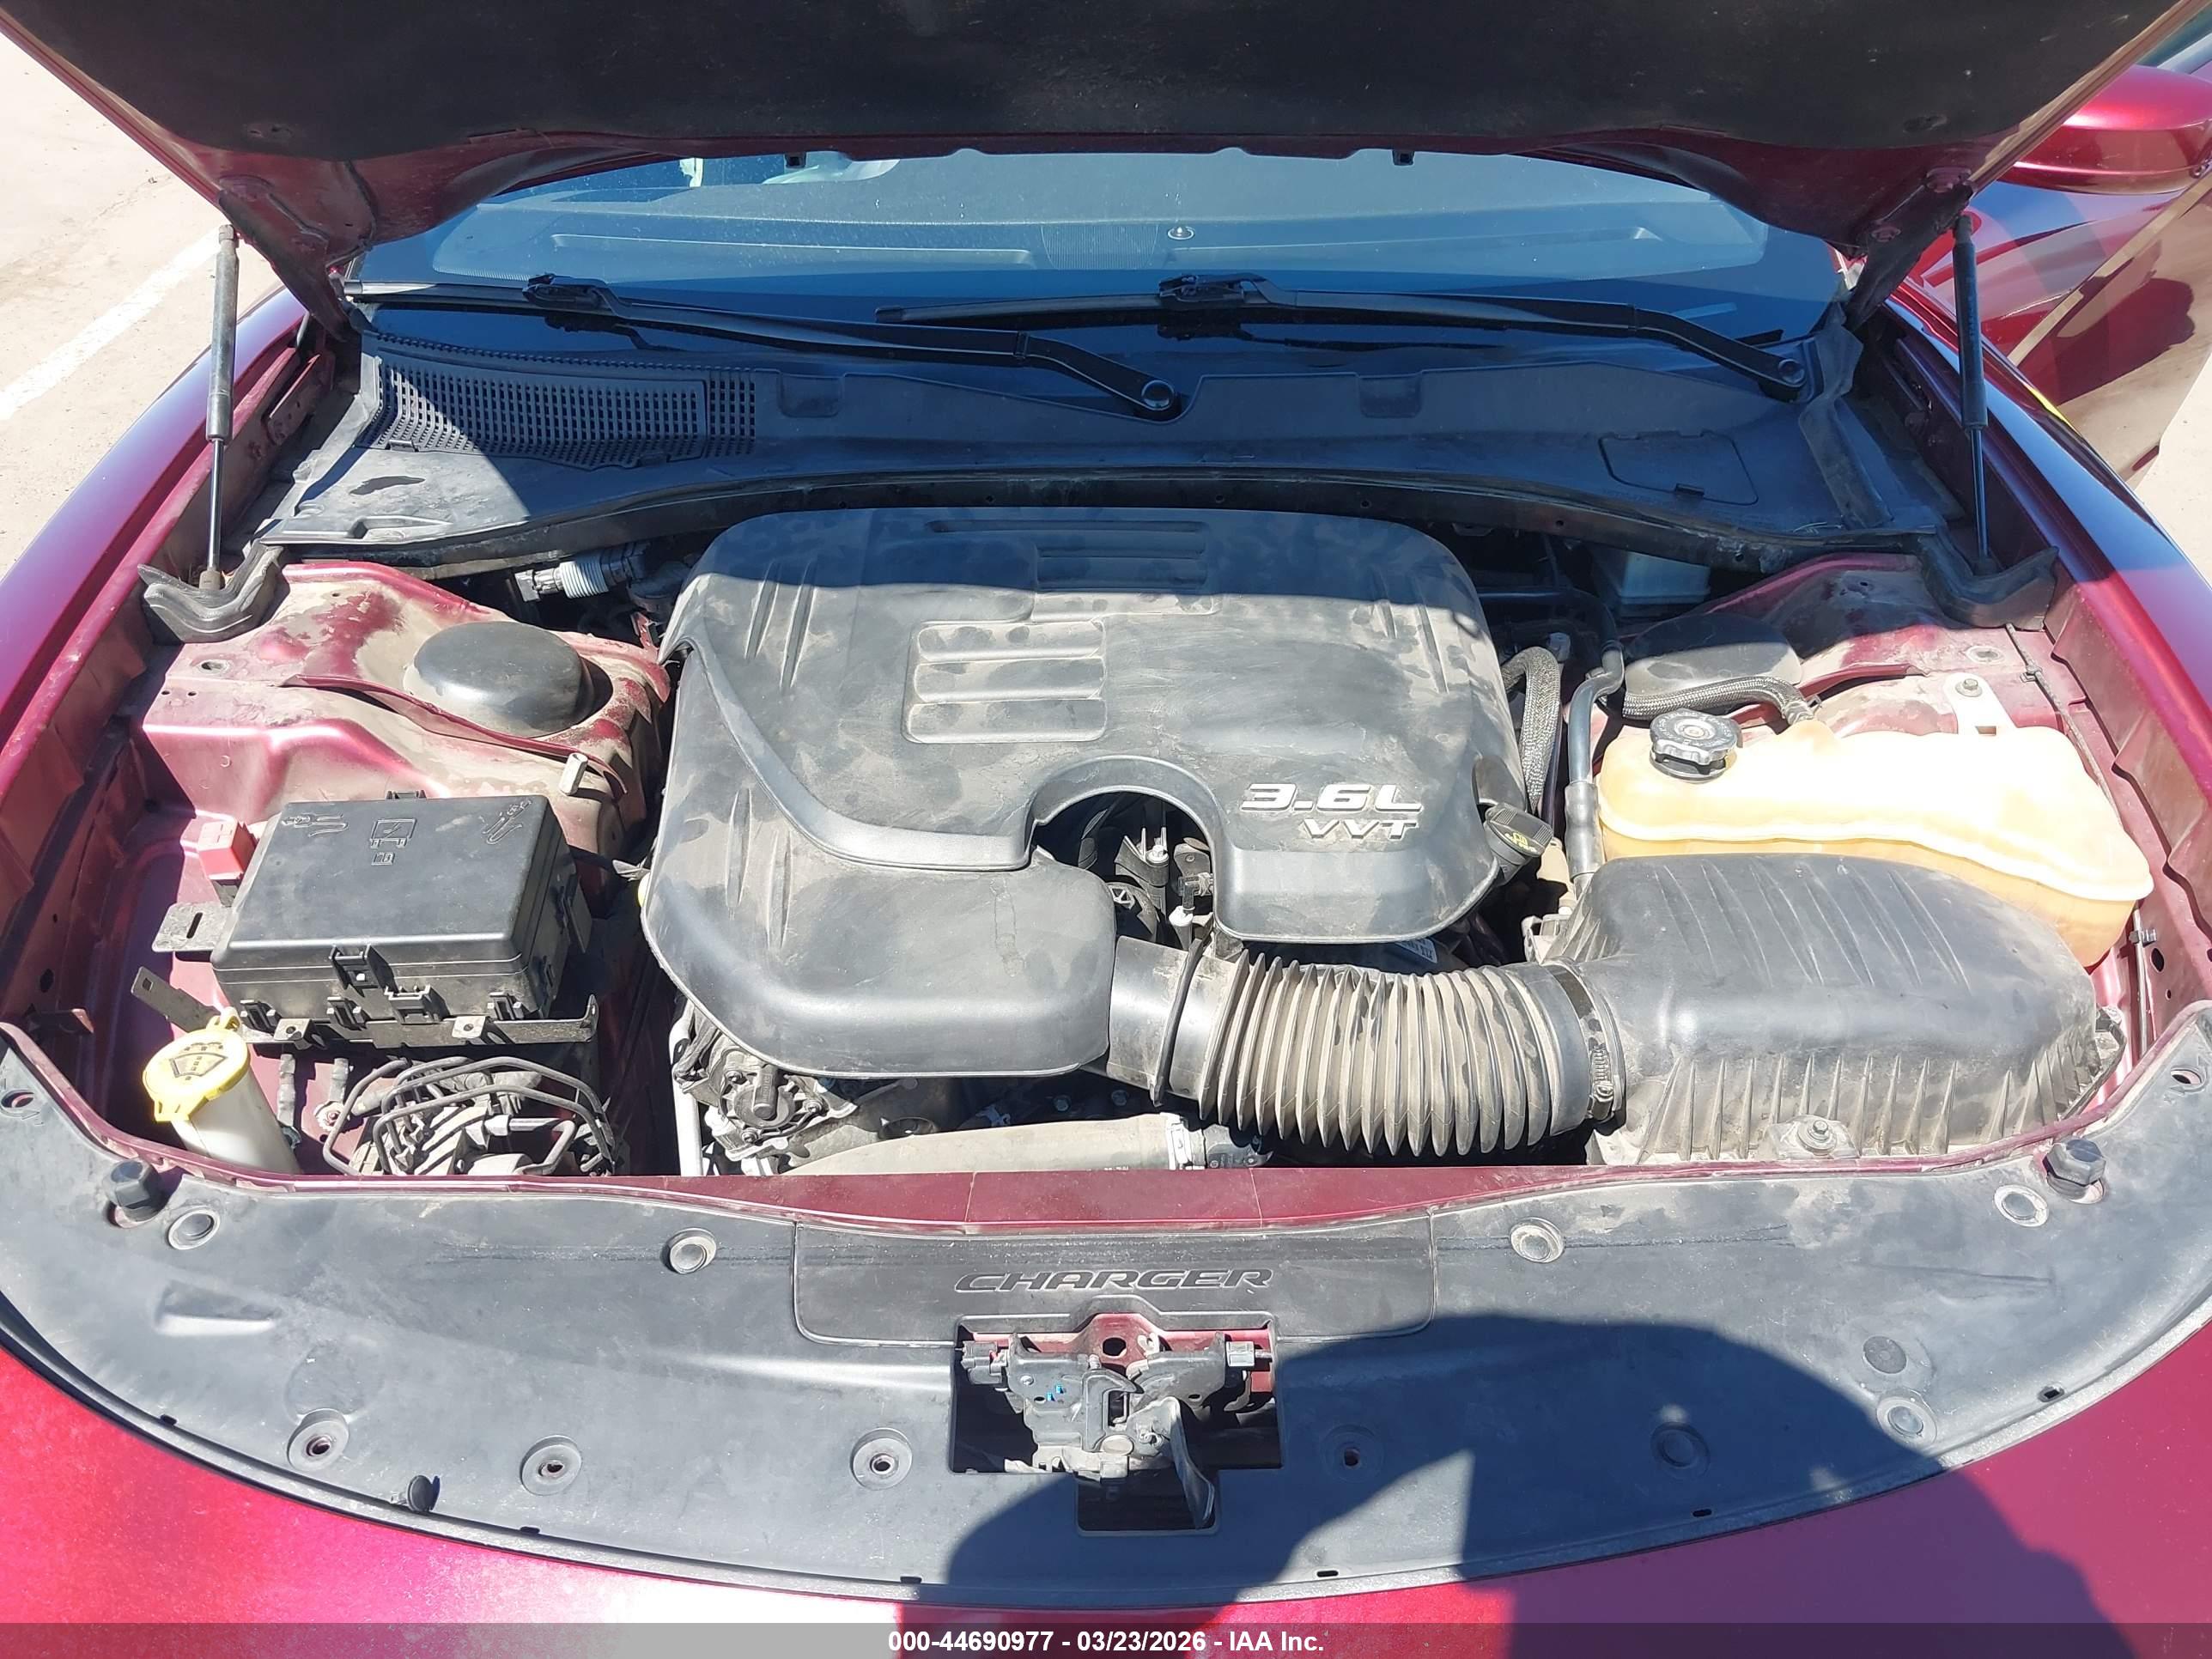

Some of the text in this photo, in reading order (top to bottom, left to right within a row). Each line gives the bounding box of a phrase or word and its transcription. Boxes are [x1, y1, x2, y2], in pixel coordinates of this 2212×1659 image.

[1241, 783, 1423, 811] 3.6L
[1303, 818, 1418, 839] VVT
[955, 1269, 1273, 1291] CHARGER
